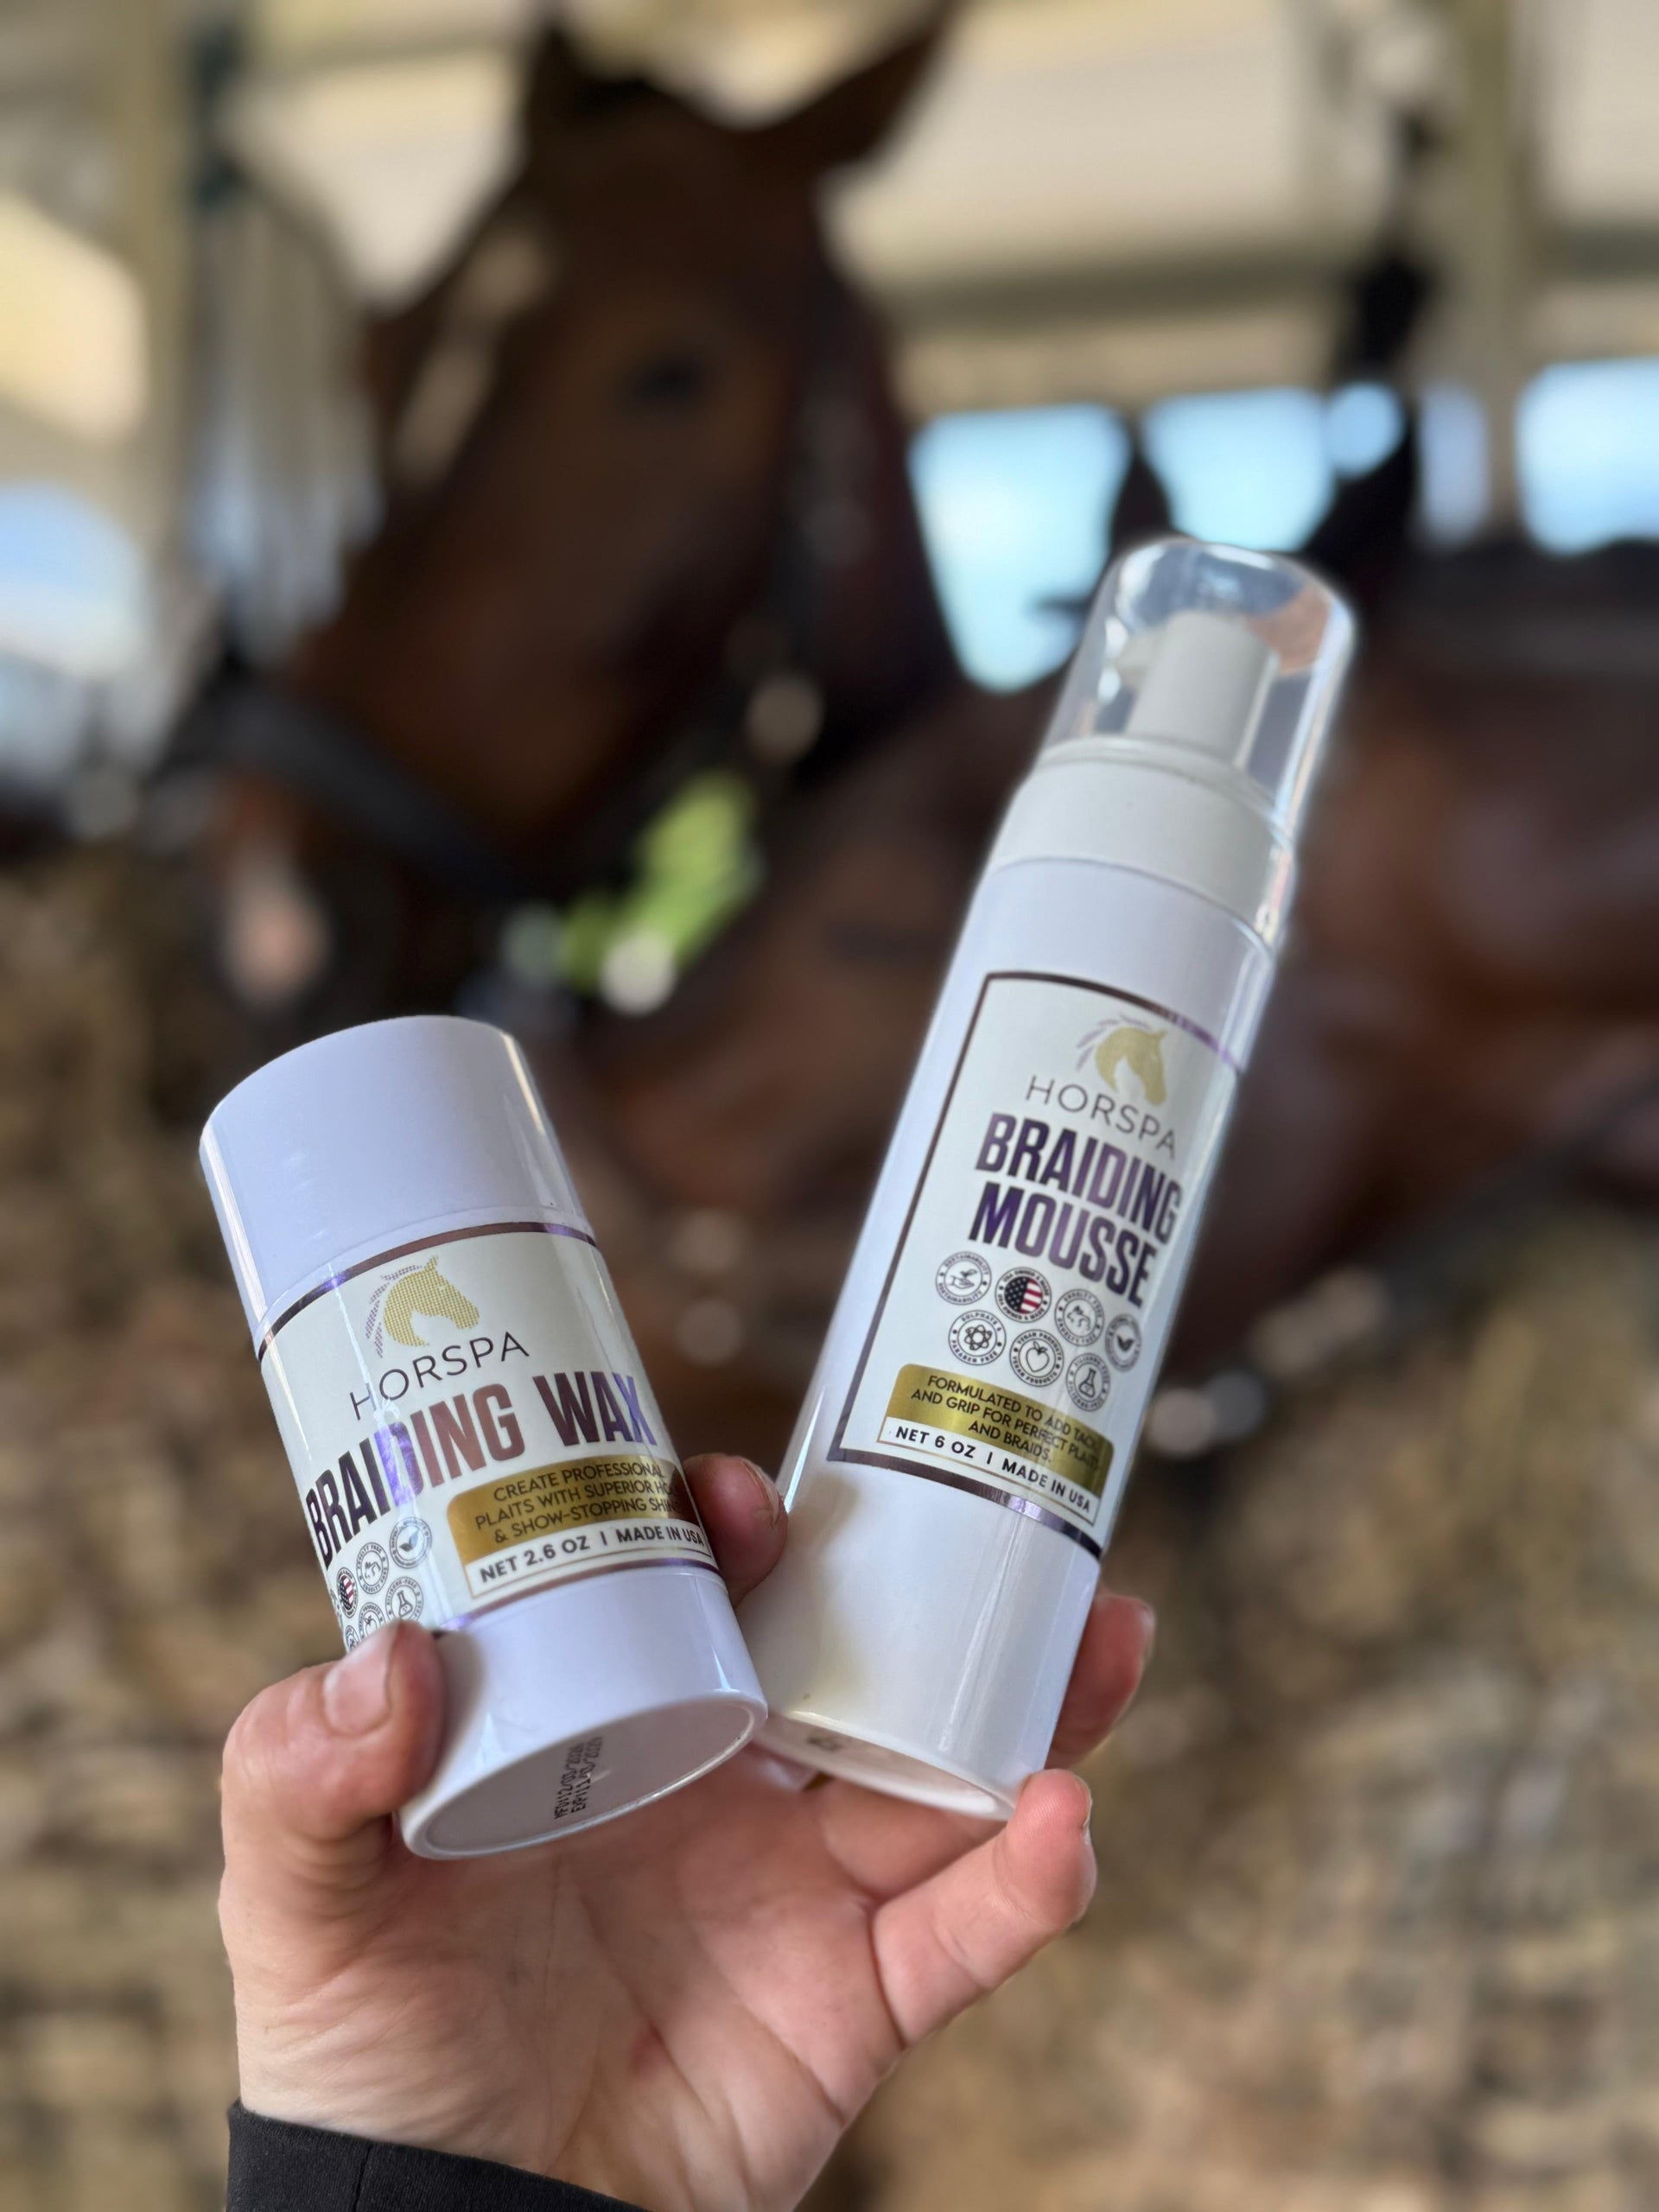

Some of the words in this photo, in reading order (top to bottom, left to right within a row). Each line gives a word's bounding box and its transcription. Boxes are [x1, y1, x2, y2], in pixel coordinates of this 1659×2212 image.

[1026, 1075, 1176, 1160] HORSPA
[976, 1112, 1182, 1245] BRAIDING
[968, 1181, 1157, 1307] MOUSSE
[961, 1313, 998, 1325] SULPHATE
[350, 1332, 530, 1421] HORSPA
[951, 1339, 977, 1363] PARABEN
[981, 1351, 998, 1363] FREE
[911, 1389, 943, 1406] AND
[946, 1396, 980, 1414] GRIP
[982, 1407, 1012, 1427] FOR
[1014, 1418, 1068, 1450] PERFECT
[927, 1376, 1020, 1413] FORMULATED
[1026, 1406, 1042, 1421] TO
[1045, 1415, 1071, 1435] ADD
[305, 1383, 525, 1571] BRAIDING
[531, 1370, 658, 1448] WAX
[896, 1427, 930, 1444] NET
[935, 1435, 945, 1448] 6
[951, 1440, 976, 1459] OZ
[1001, 1458, 1048, 1487] MADE
[1051, 1479, 1066, 1497] IN
[1069, 1489, 1091, 1513] USA
[968, 1421, 1001, 1440] AND
[1003, 1429, 1051, 1463] BRAIDS.
[475, 1500, 535, 1531] PLAITS
[537, 1487, 582, 1509] WITH
[584, 1479, 653, 1499] SUPERIOR
[493, 1473, 559, 1503] CREATE
[563, 1462, 664, 1486] PROFESSIONAL
[494, 1529, 509, 1543] &
[512, 1497, 647, 1539] SHOW-STOPPING
[648, 1497, 679, 1513] SHIN
[480, 1557, 518, 1583] NET
[524, 1543, 556, 1567] 2.6
[562, 1536, 591, 1554] OZ
[616, 1526, 664, 1543] MADE
[665, 1526, 683, 1541] IN
[682, 1528, 705, 1547] USA
